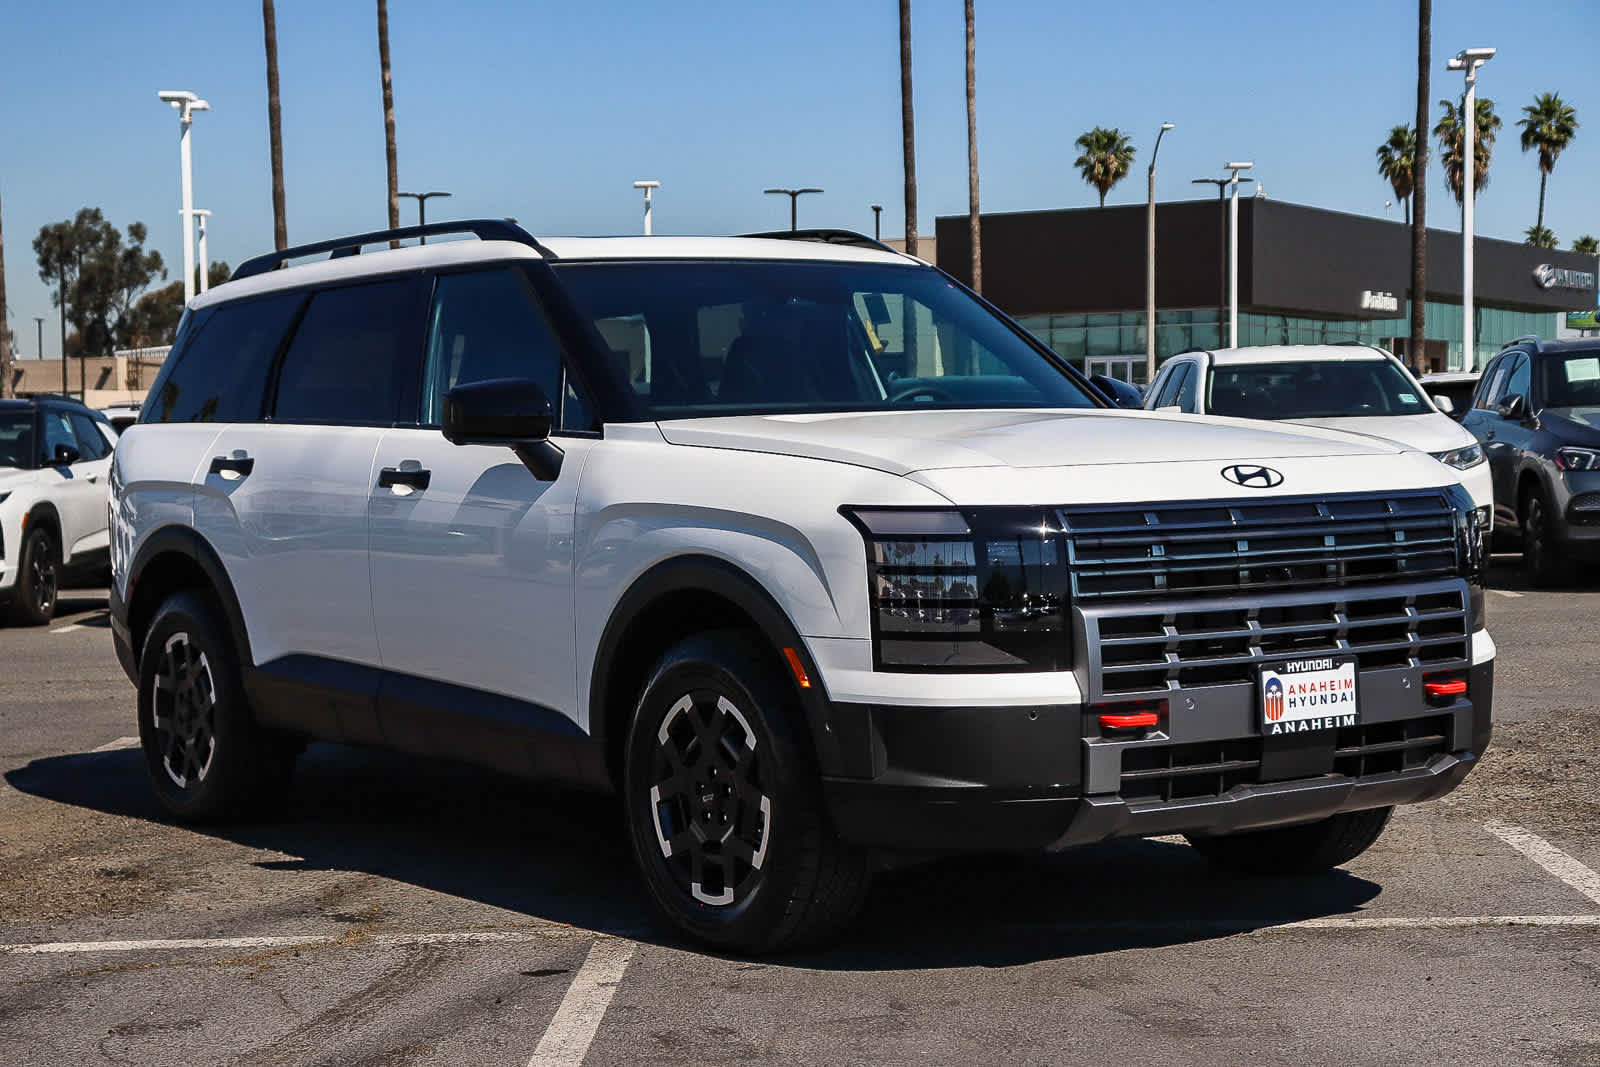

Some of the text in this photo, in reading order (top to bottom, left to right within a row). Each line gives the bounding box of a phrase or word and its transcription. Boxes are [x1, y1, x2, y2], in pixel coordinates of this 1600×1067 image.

[1287, 659, 1333, 673] HYUNDAI
[1288, 679, 1353, 695] ANAHEIM
[1289, 691, 1353, 708] HYUNDAI
[1271, 715, 1355, 735] ANAHEIM
